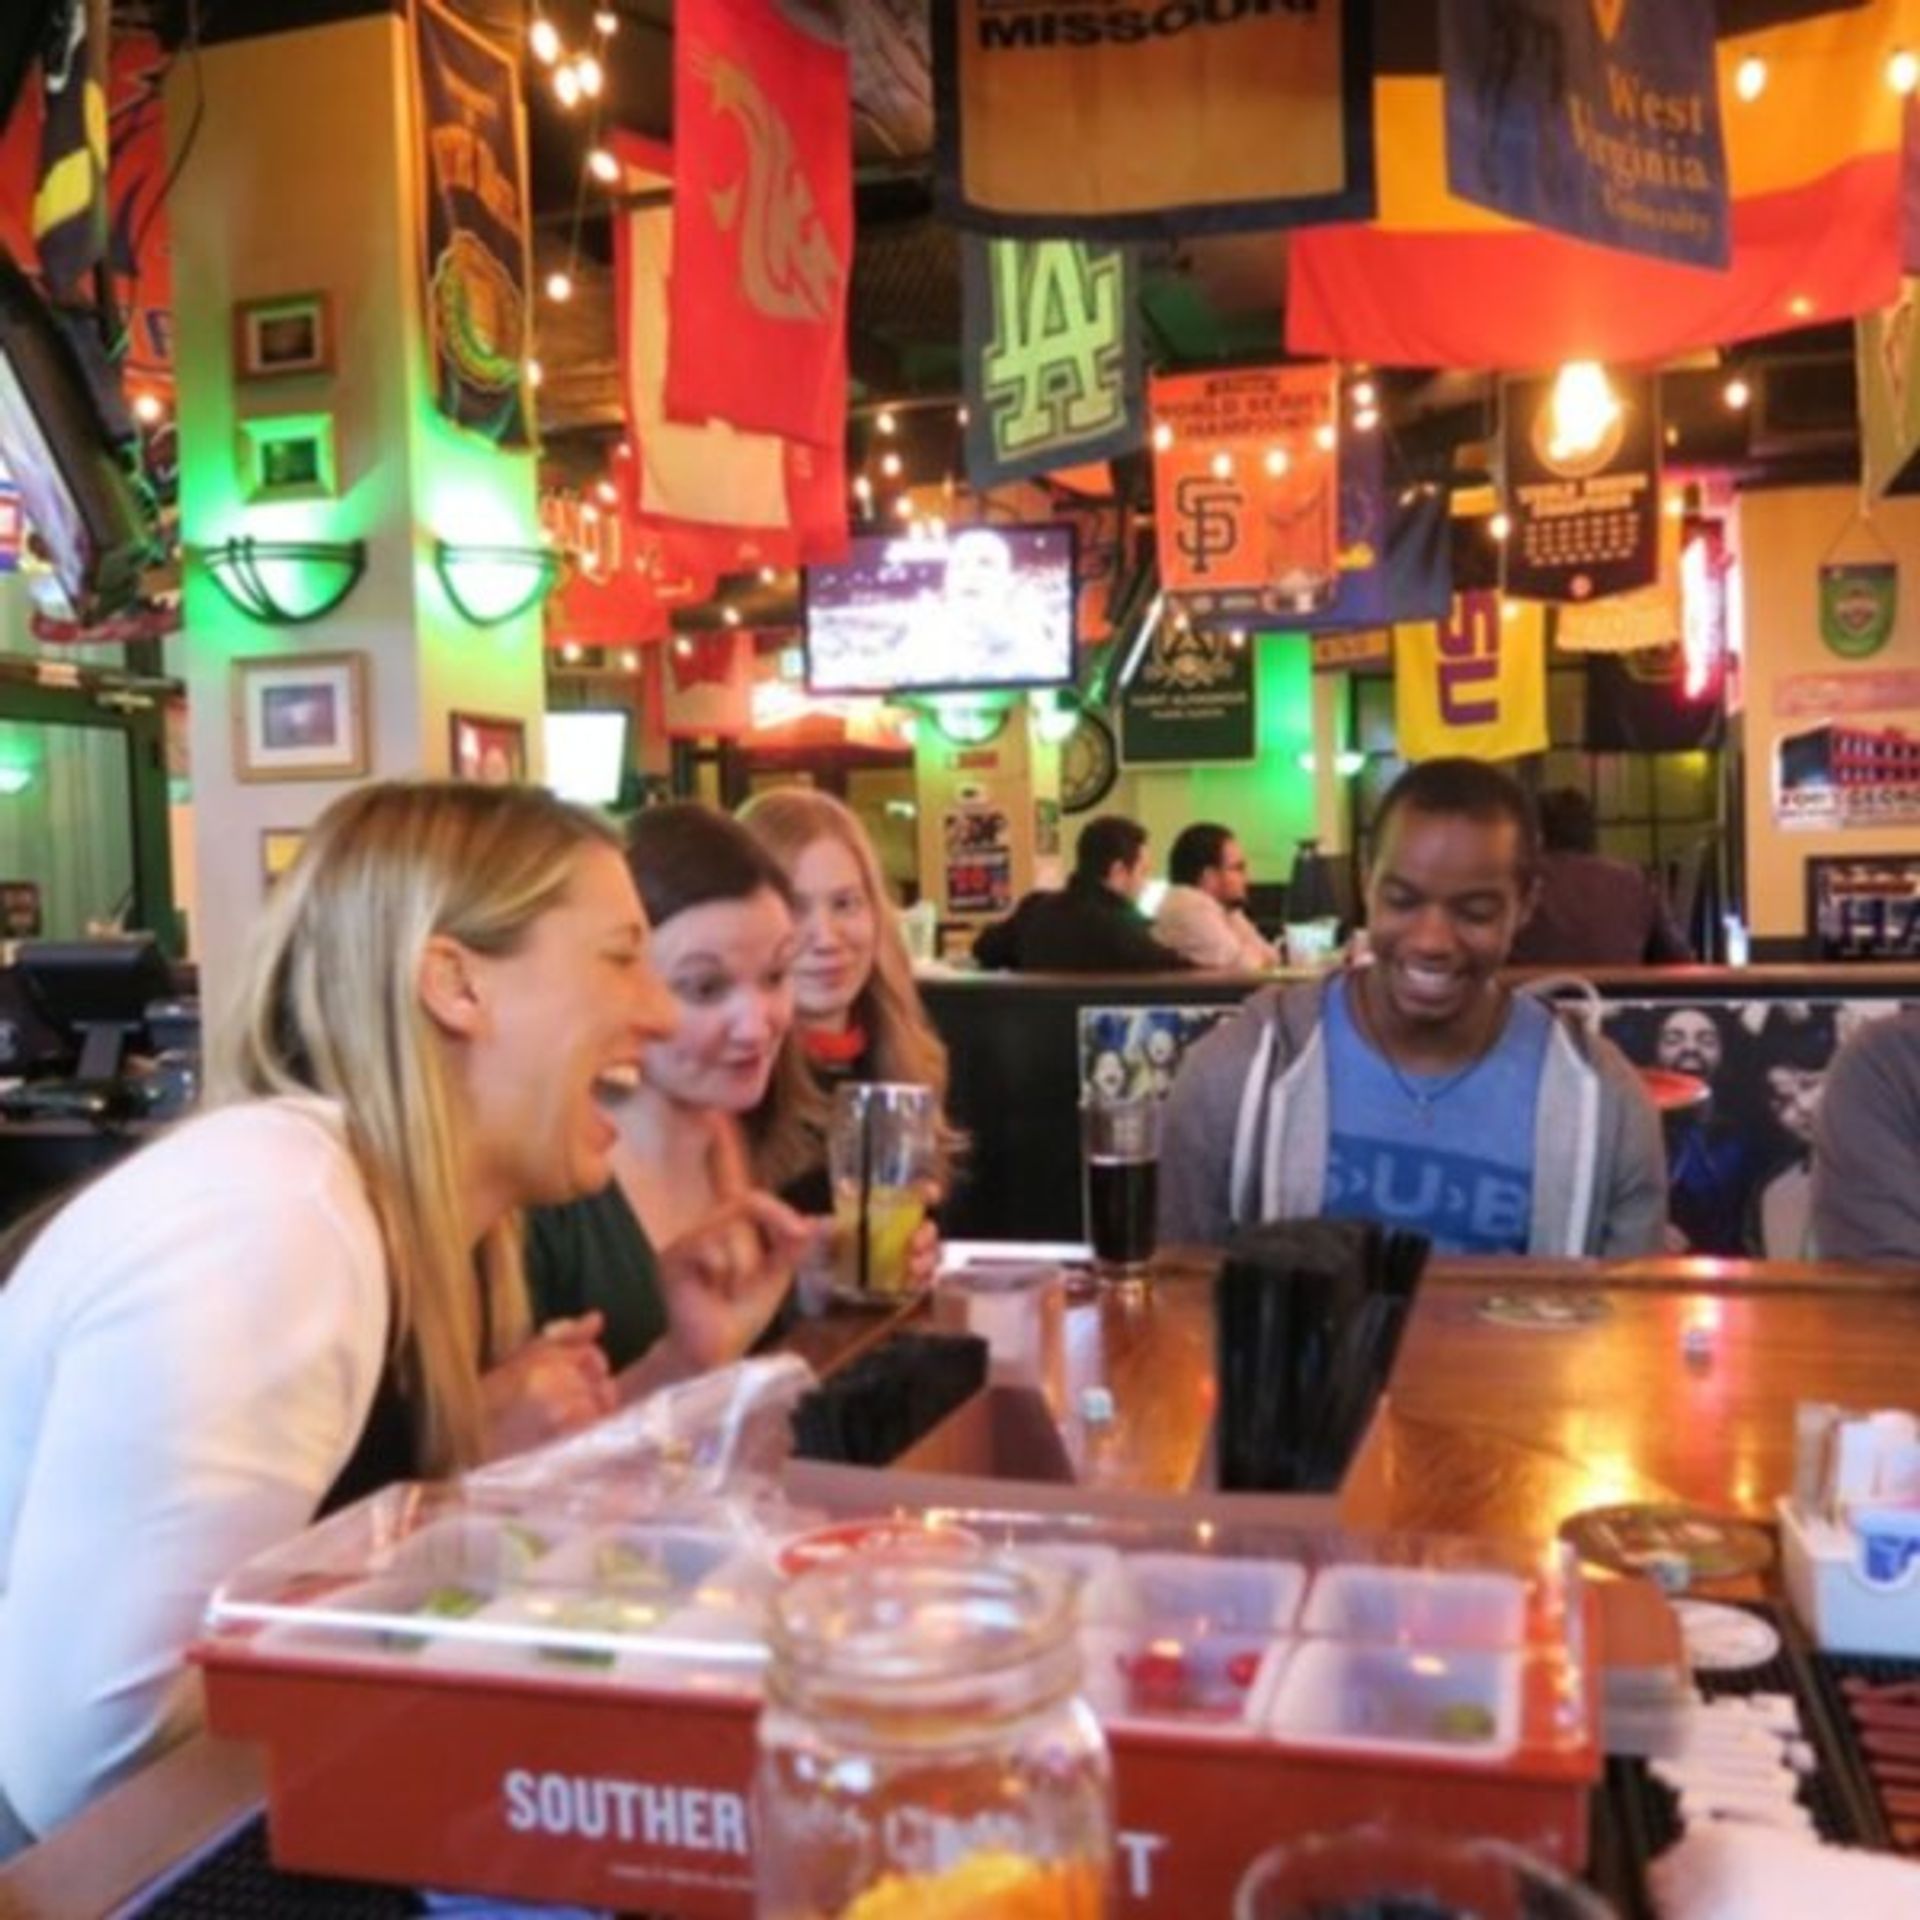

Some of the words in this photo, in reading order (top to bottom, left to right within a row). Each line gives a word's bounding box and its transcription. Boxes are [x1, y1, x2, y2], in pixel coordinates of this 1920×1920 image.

[1568, 96, 1710, 192] Virginia
[1609, 66, 1703, 136] West
[983, 240, 1127, 462] LA
[1176, 475, 1244, 574] SF
[1437, 588, 1499, 726] SU
[504, 1768, 750, 1857] SOUTHER
